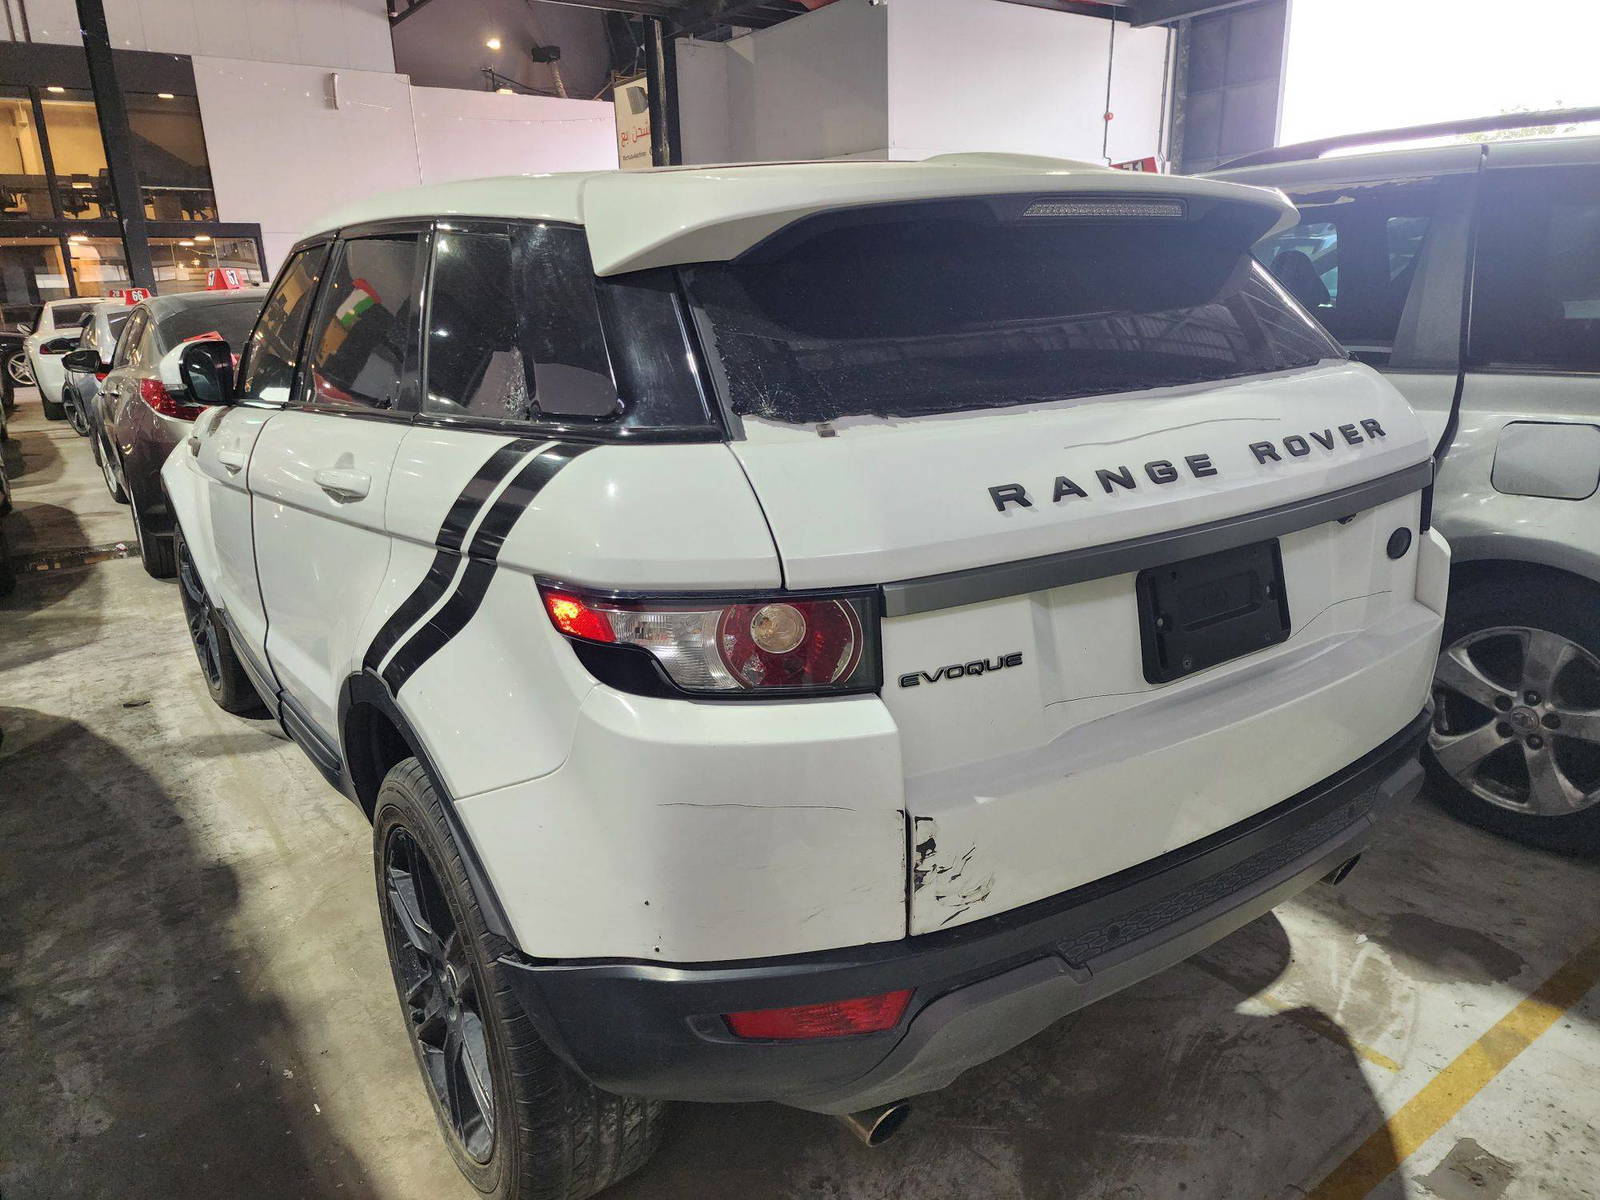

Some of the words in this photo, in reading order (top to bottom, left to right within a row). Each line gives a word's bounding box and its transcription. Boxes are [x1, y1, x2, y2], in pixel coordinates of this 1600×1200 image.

[226, 270, 240, 286] 67
[132, 290, 145, 302] 66
[988, 453, 1218, 512] RANGE
[1249, 418, 1386, 465] ROVER
[899, 651, 1023, 688] EVOQUE
